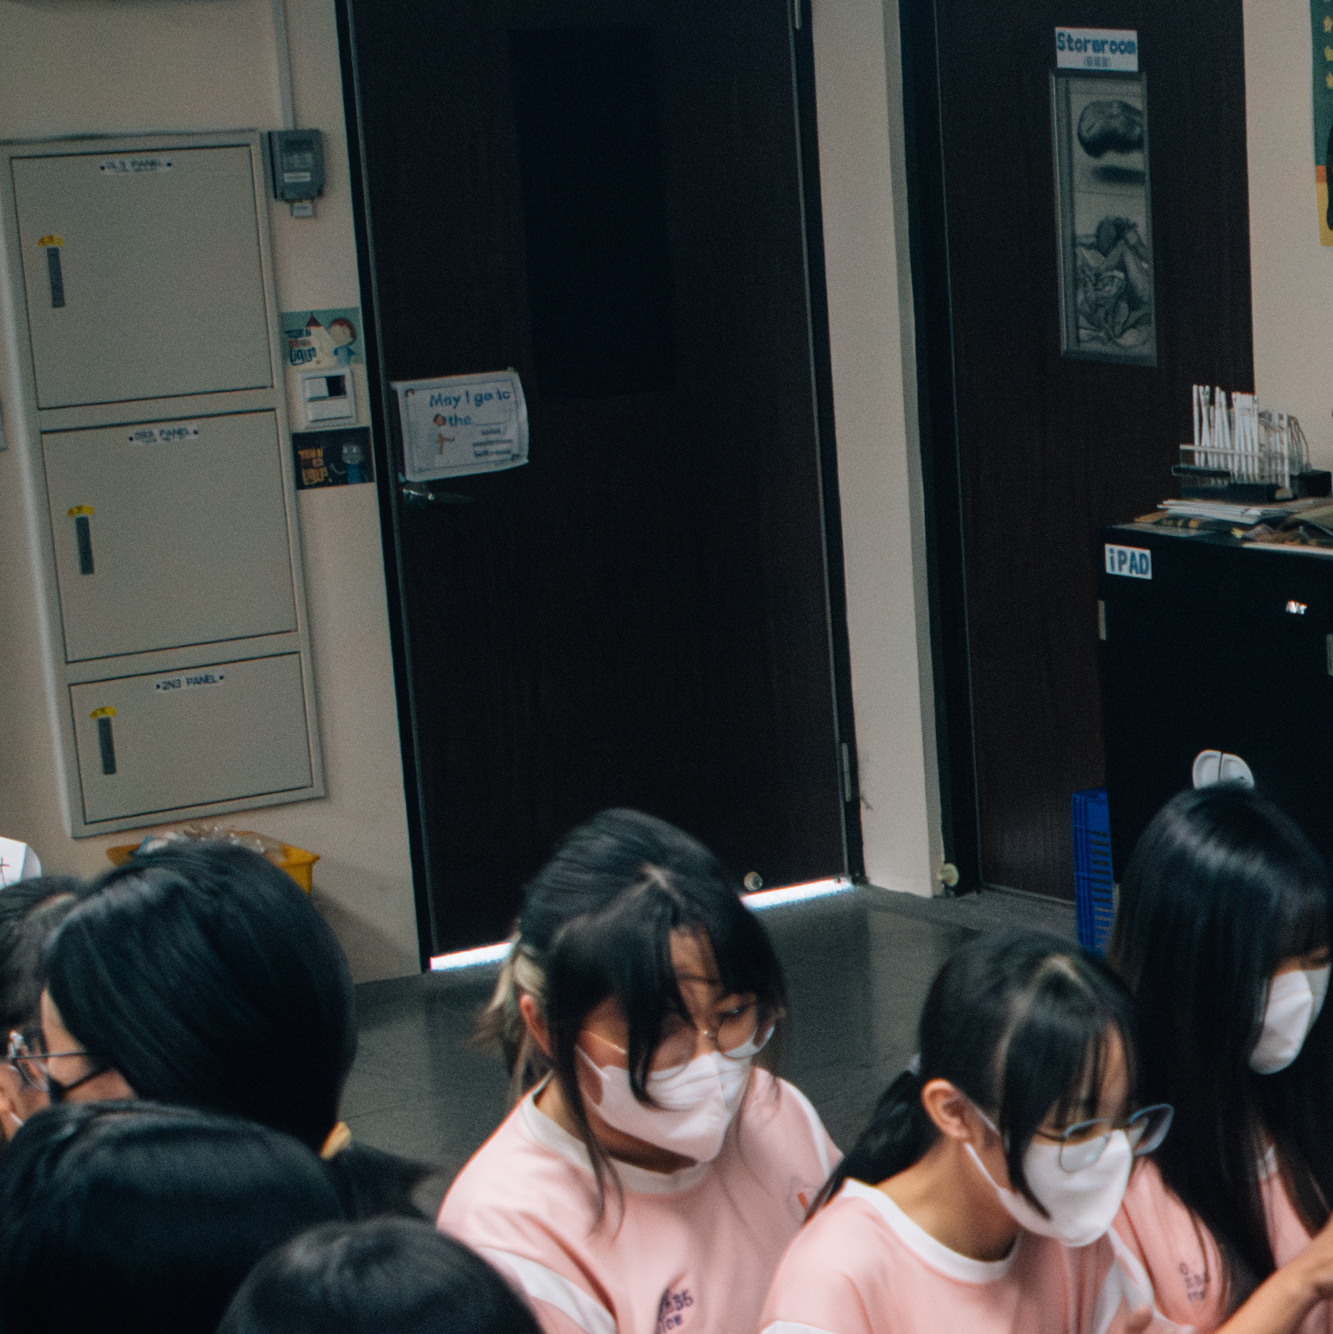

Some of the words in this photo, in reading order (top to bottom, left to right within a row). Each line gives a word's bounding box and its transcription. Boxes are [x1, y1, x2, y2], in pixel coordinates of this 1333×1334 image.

[429, 393, 462, 408] May
[474, 391, 493, 407] go
[497, 389, 511, 402] to
[448, 413, 472, 427] the
[1109, 547, 1150, 576] iPAD
[186, 674, 218, 687] PANEL
